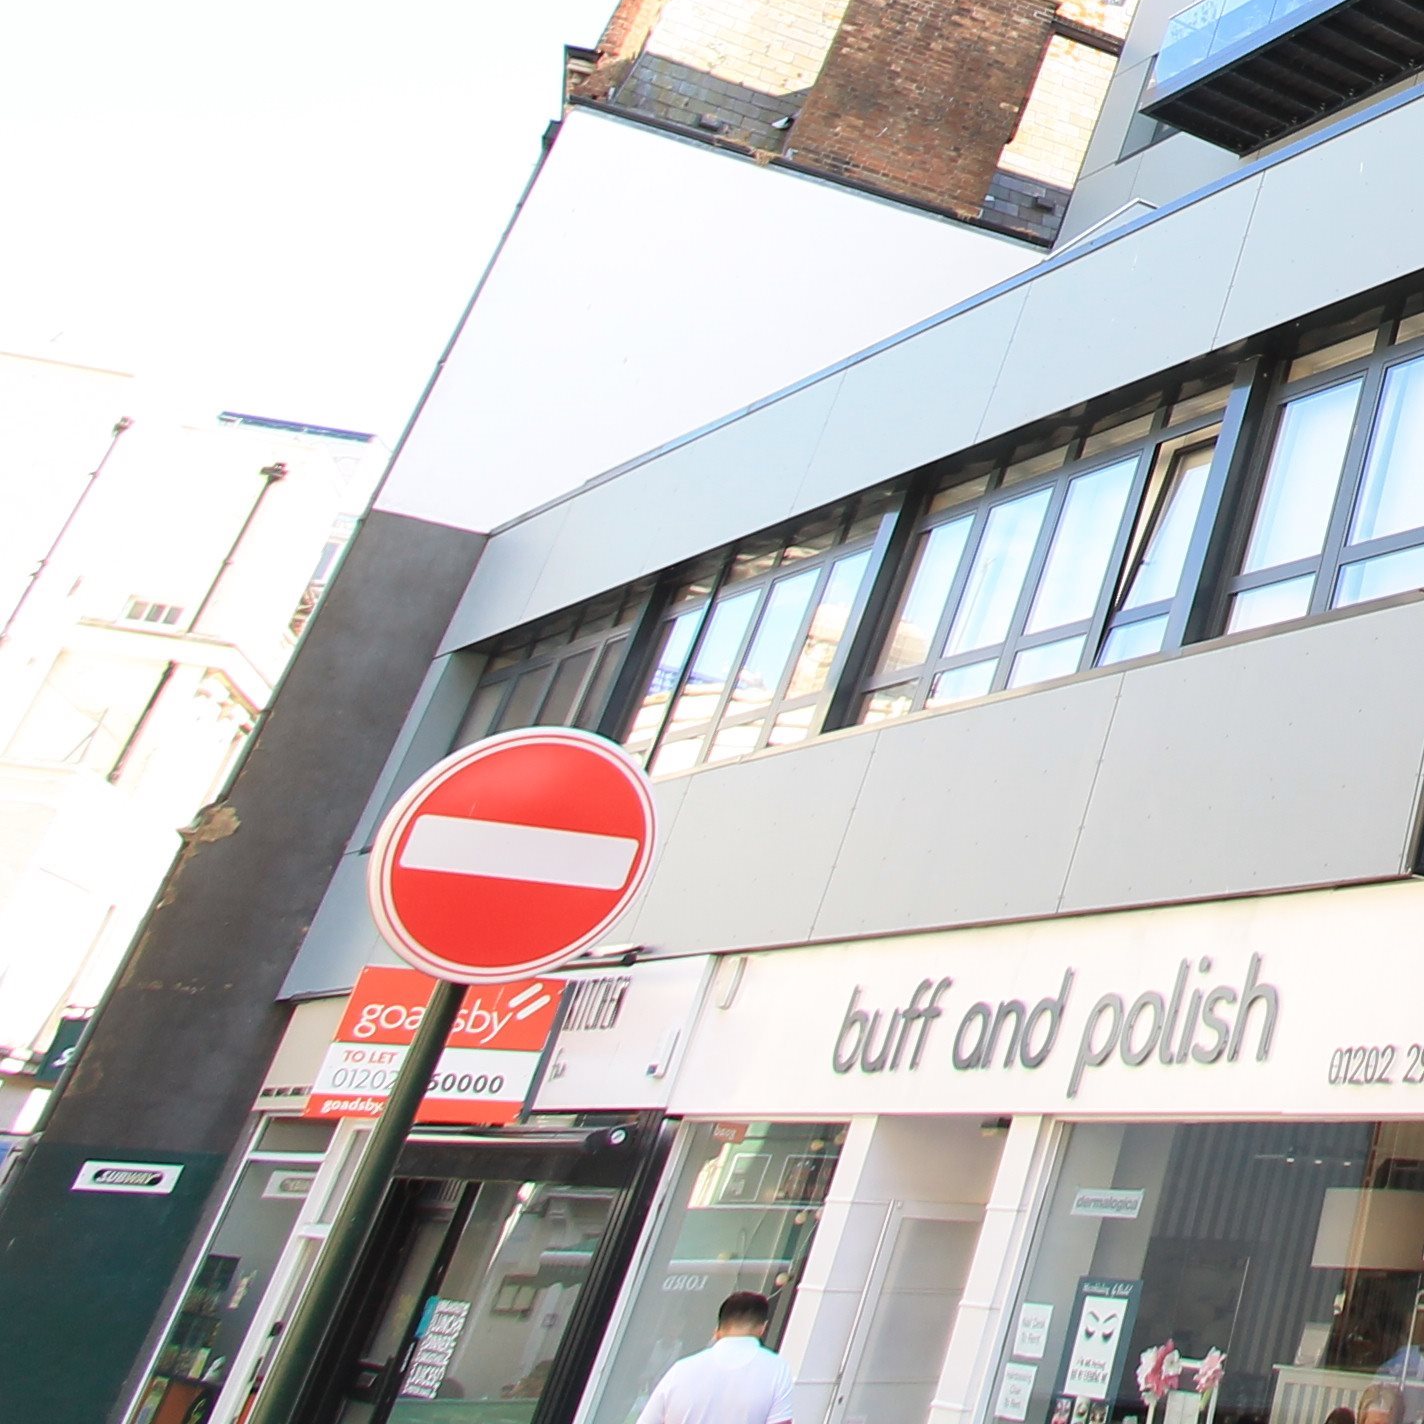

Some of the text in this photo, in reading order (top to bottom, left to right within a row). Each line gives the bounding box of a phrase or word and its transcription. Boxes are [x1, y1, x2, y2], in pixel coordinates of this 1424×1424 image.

[353, 998, 514, 1044] goasby
[833, 952, 1279, 1098] buff and polish
[344, 1050, 400, 1065] TO LET
[1328, 1044, 1396, 1085] 01202
[331, 1067, 400, 1091] 01202
[97, 1170, 161, 1185] SUBWAY
[1077, 1196, 1138, 1211] dermalogica
